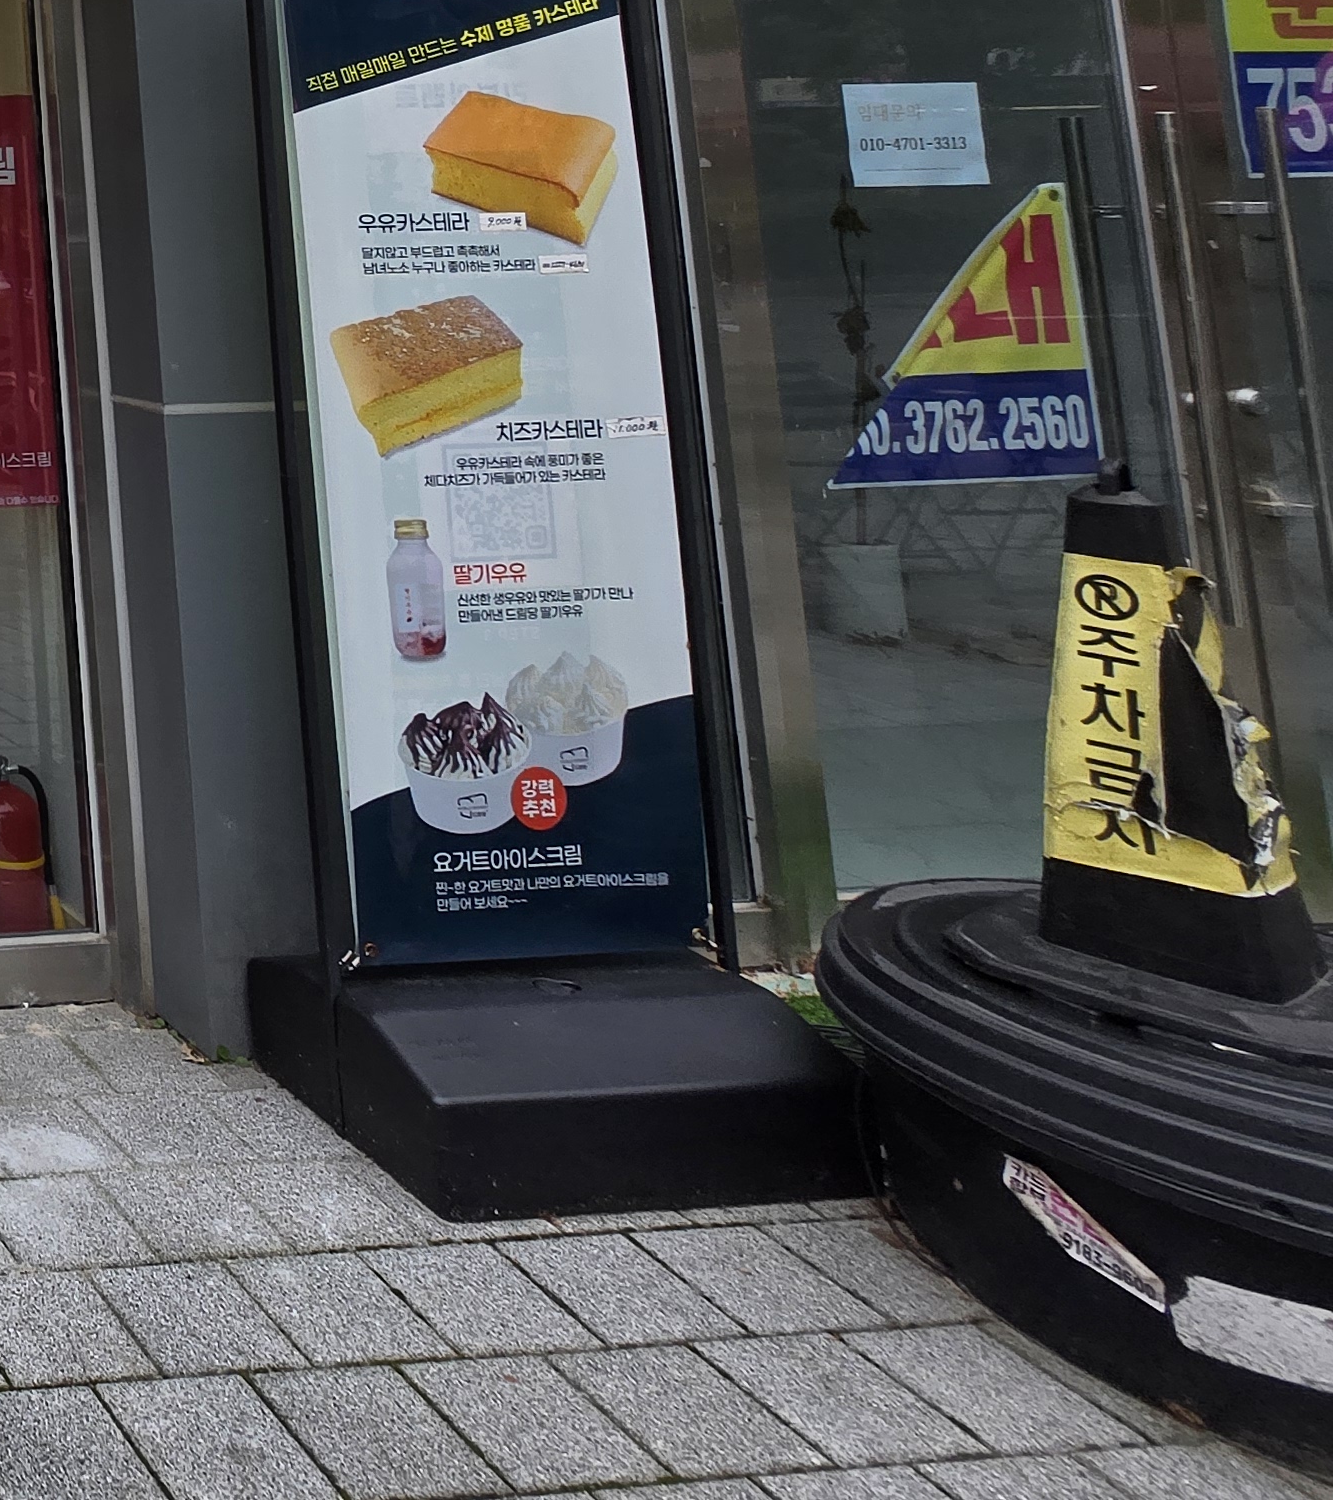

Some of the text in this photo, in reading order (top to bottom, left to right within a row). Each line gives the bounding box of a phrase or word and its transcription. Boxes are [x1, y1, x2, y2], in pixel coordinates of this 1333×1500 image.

[306, 71, 340, 93] 직접
[340, 51, 408, 85] 매일매일
[408, 38, 459, 63] 만드는
[460, 24, 495, 48] 수제
[495, 13, 532, 37] 명품
[860, 136, 967, 151] 010-4701-3313
[358, 212, 470, 233] 우유카스테라
[362, 244, 500, 260] 달지않고 부드럽고 촉촉해서
[363, 261, 410, 276] 남녀노소
[412, 261, 445, 274] 누구나
[448, 260, 491, 273] 좋아하는
[493, 259, 535, 272] 카스테라
[496, 419, 603, 441] 치즈카스테라
[456, 453, 605, 470] 우유카스테라 속에 풍미가 좋은
[424, 468, 606, 487] 체다치즈가 가득들어가 있는 카스테라
[453, 562, 527, 585] 딸기우유
[457, 587, 634, 607] 신선한 생우유와 맛있는 딸기가 만나
[458, 604, 584, 624] 만들어낸 드림당 딸기우유
[1077, 624, 1156, 855] 주차금지
[521, 779, 554, 798] 강력
[522, 798, 556, 818] 추천
[433, 844, 583, 873] 요거트아이스크림
[468, 878, 525, 893] 요거트맛과
[527, 875, 561, 890] 나만의
[563, 872, 670, 888] 요거트아이스크림을
[437, 898, 472, 912] 만들어
